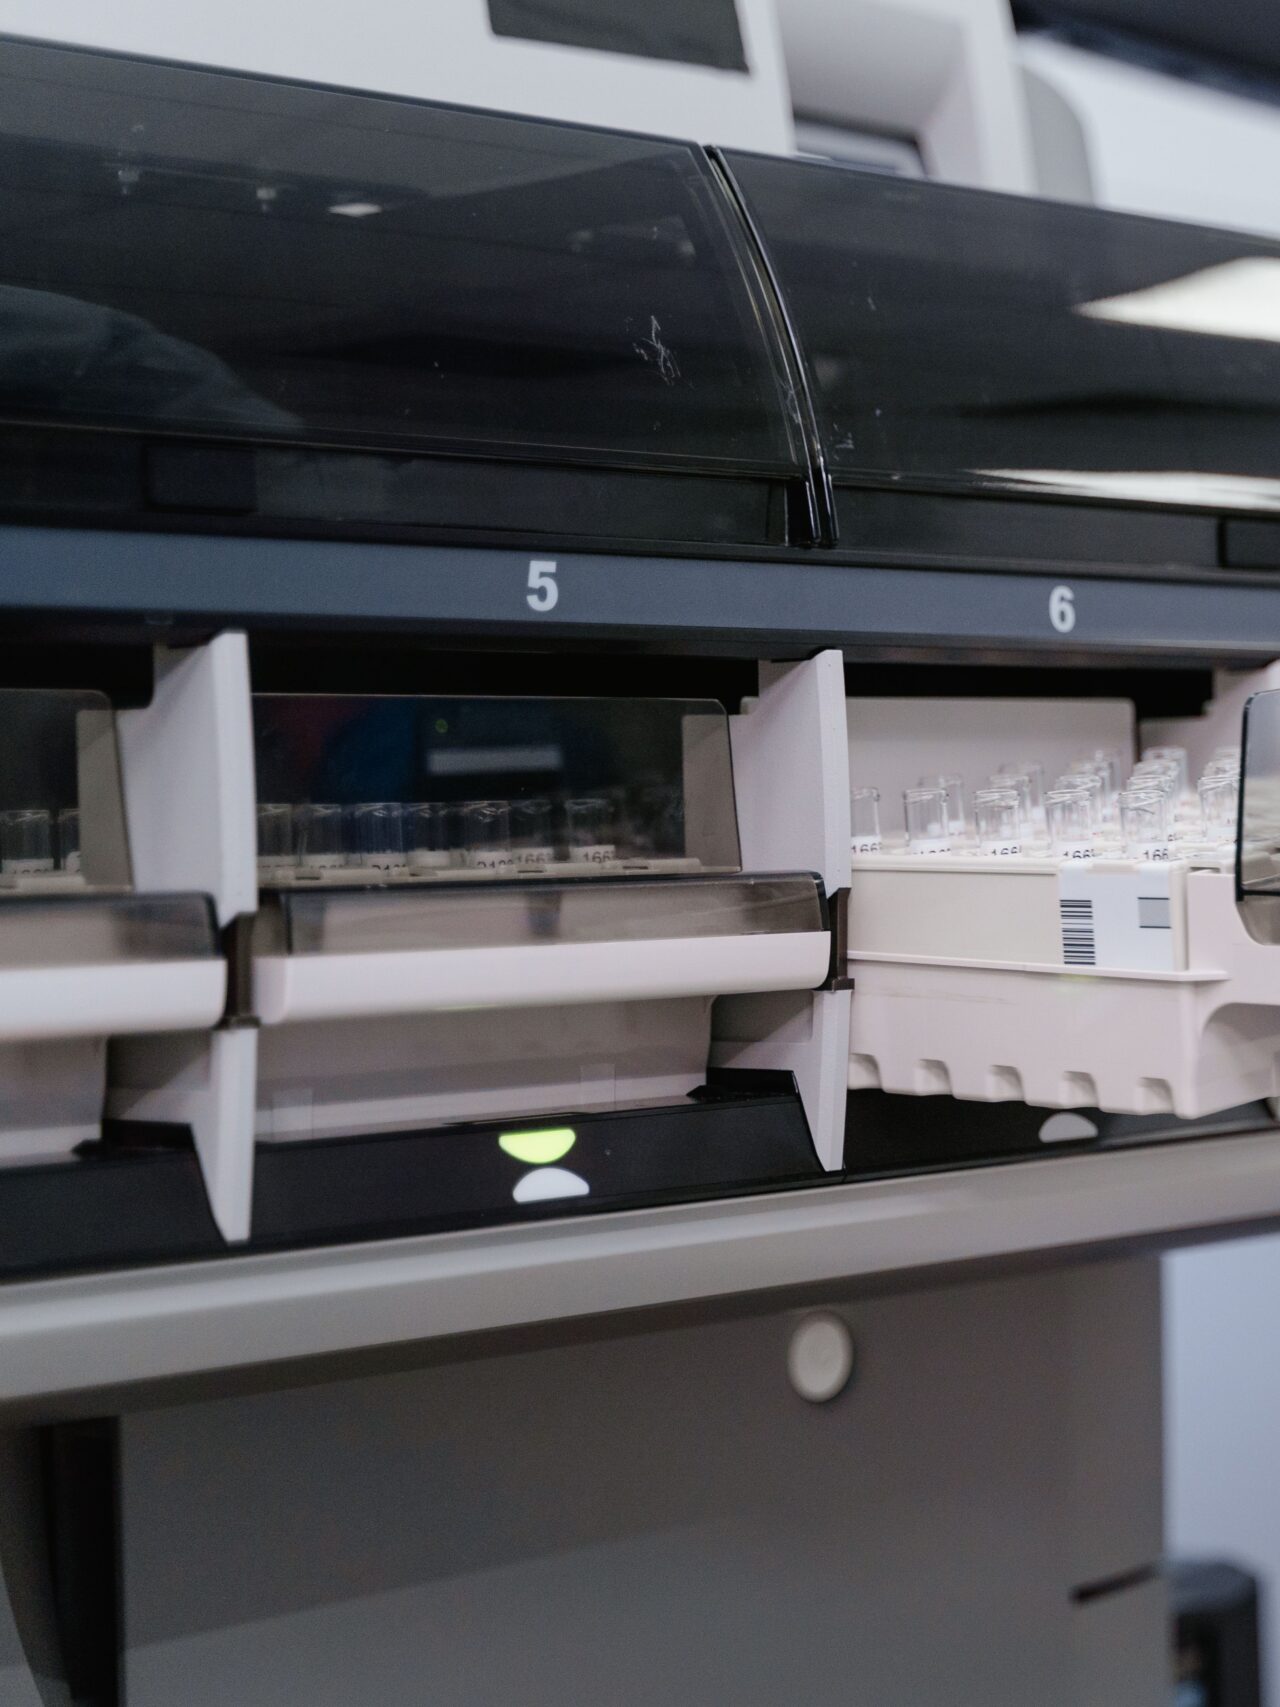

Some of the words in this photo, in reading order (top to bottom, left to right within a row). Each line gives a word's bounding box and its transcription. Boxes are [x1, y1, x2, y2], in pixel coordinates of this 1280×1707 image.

[526, 560, 559, 612] 5
[1049, 585, 1076, 634] 6
[582, 850, 615, 864] 166
